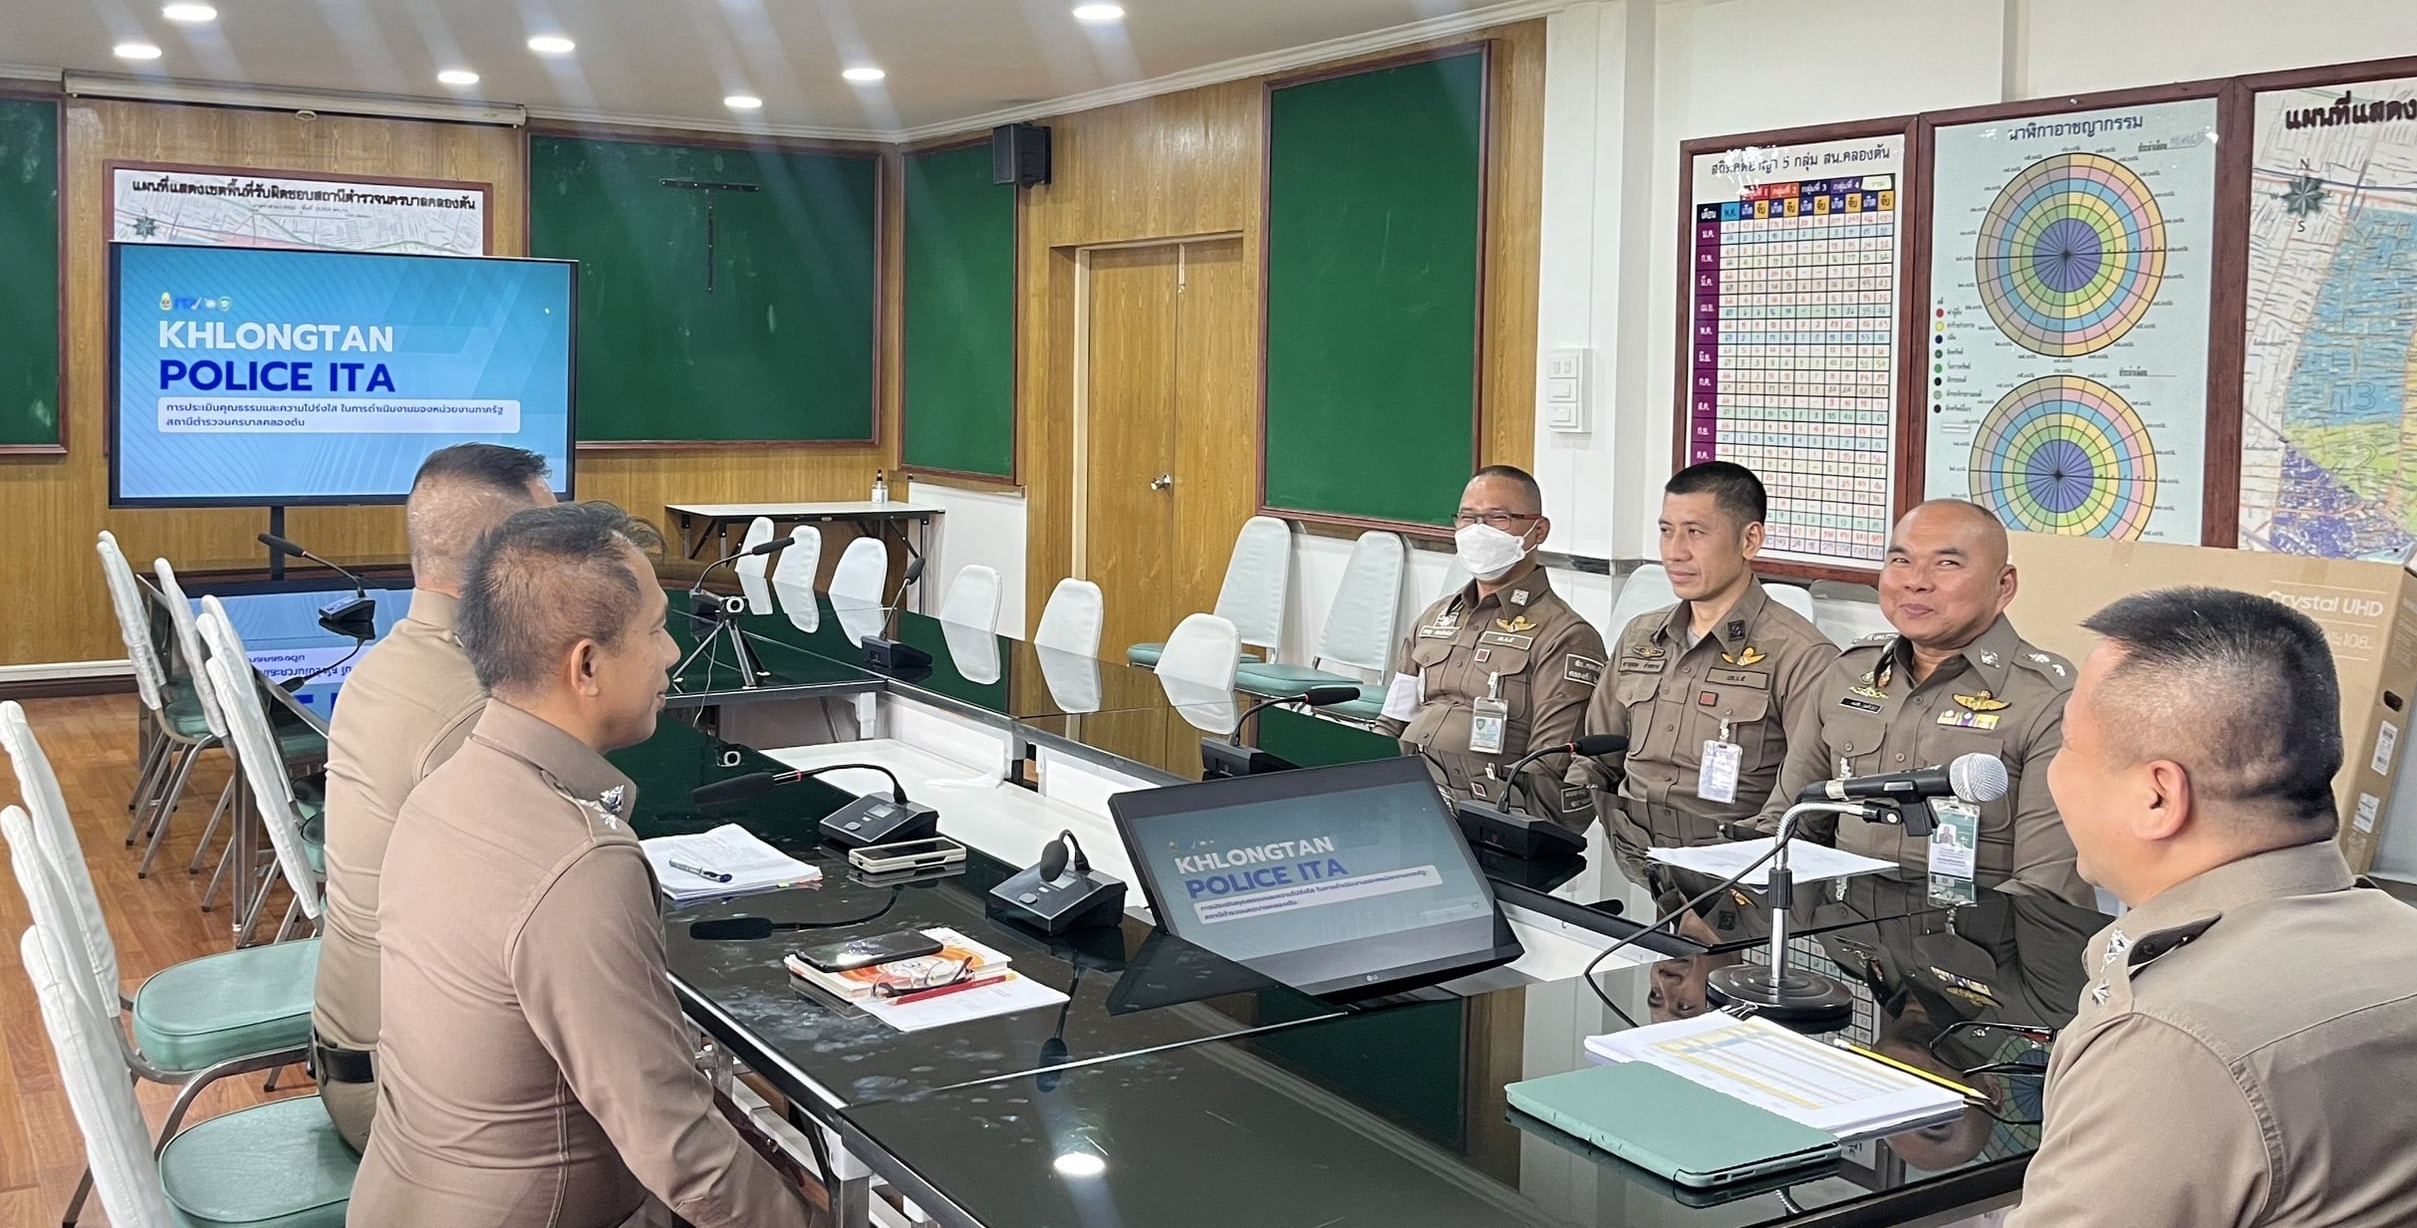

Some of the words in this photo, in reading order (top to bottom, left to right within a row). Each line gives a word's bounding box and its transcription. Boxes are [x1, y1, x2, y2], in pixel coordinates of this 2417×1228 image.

[1794, 152, 1818, 171] กลุ่ม
[1823, 144, 1891, 165] สน.คลองตัน
[2300, 158, 2310, 170] N
[2297, 221, 2306, 233] S
[159, 320, 394, 353] KHLONGTAN
[160, 359, 313, 392] POLICE
[329, 362, 396, 393] ITA
[166, 416, 305, 427] สถานีตำรวจนครบาลคลองตัน
[2343, 598, 2384, 617] UHD
[1174, 836, 1335, 875] KHLONGTAN
[1184, 865, 1293, 899] POLICE
[1297, 858, 1348, 881] ITA
